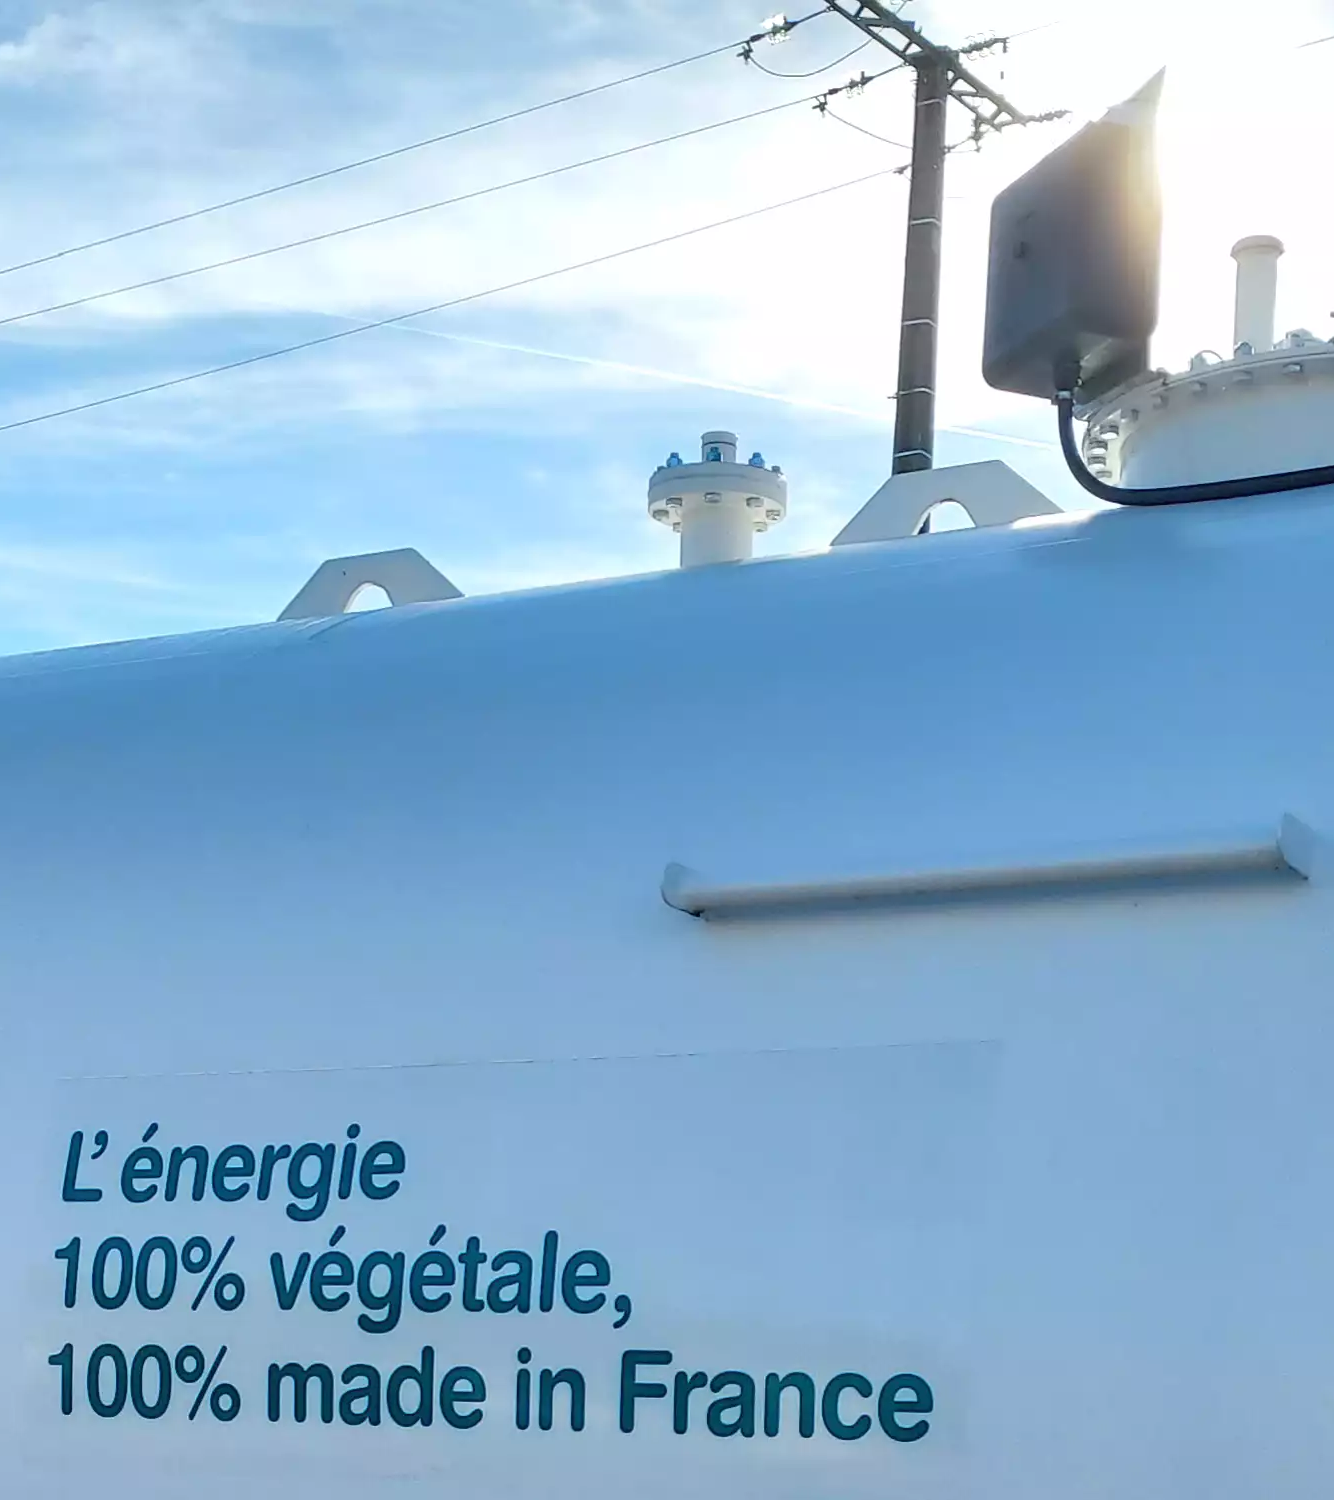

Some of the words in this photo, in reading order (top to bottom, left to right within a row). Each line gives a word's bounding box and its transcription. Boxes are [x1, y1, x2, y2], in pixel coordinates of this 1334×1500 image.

[61, 1121, 406, 1222] L’énergie
[53, 1234, 246, 1312] 100%
[269, 1222, 633, 1335] végétale,
[47, 1342, 242, 1422] 100%
[266, 1345, 487, 1430] made
[514, 1346, 586, 1433] in
[618, 1349, 934, 1443] France
